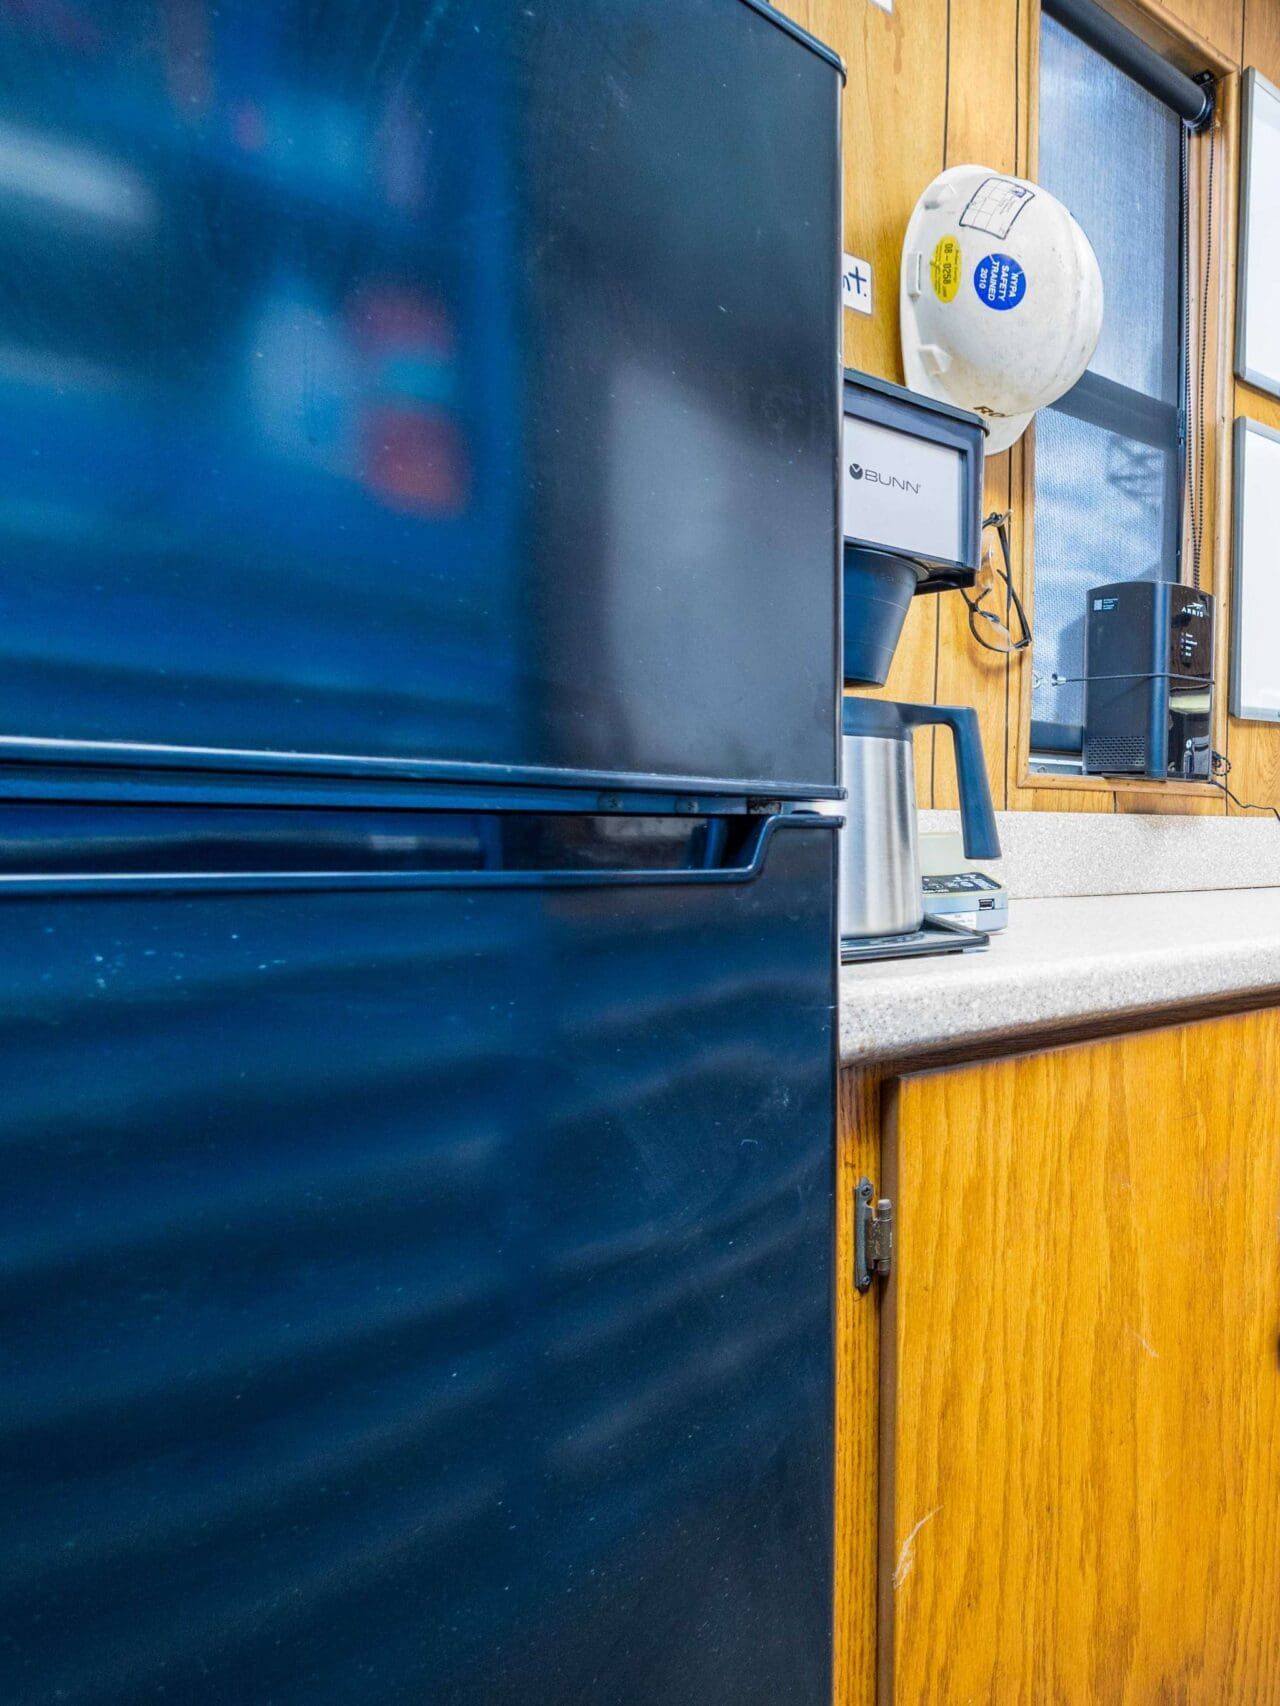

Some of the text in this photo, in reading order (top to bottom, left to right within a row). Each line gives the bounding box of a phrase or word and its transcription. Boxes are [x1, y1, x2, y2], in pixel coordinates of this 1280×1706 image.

[978, 267, 988, 289] 2010
[988, 261, 1000, 301] TRAINED
[998, 265, 1010, 301] SAFETY
[1008, 272, 1019, 298] NYPA
[864, 468, 920, 495] BUNN
[1181, 606, 1204, 618] ARRIS
